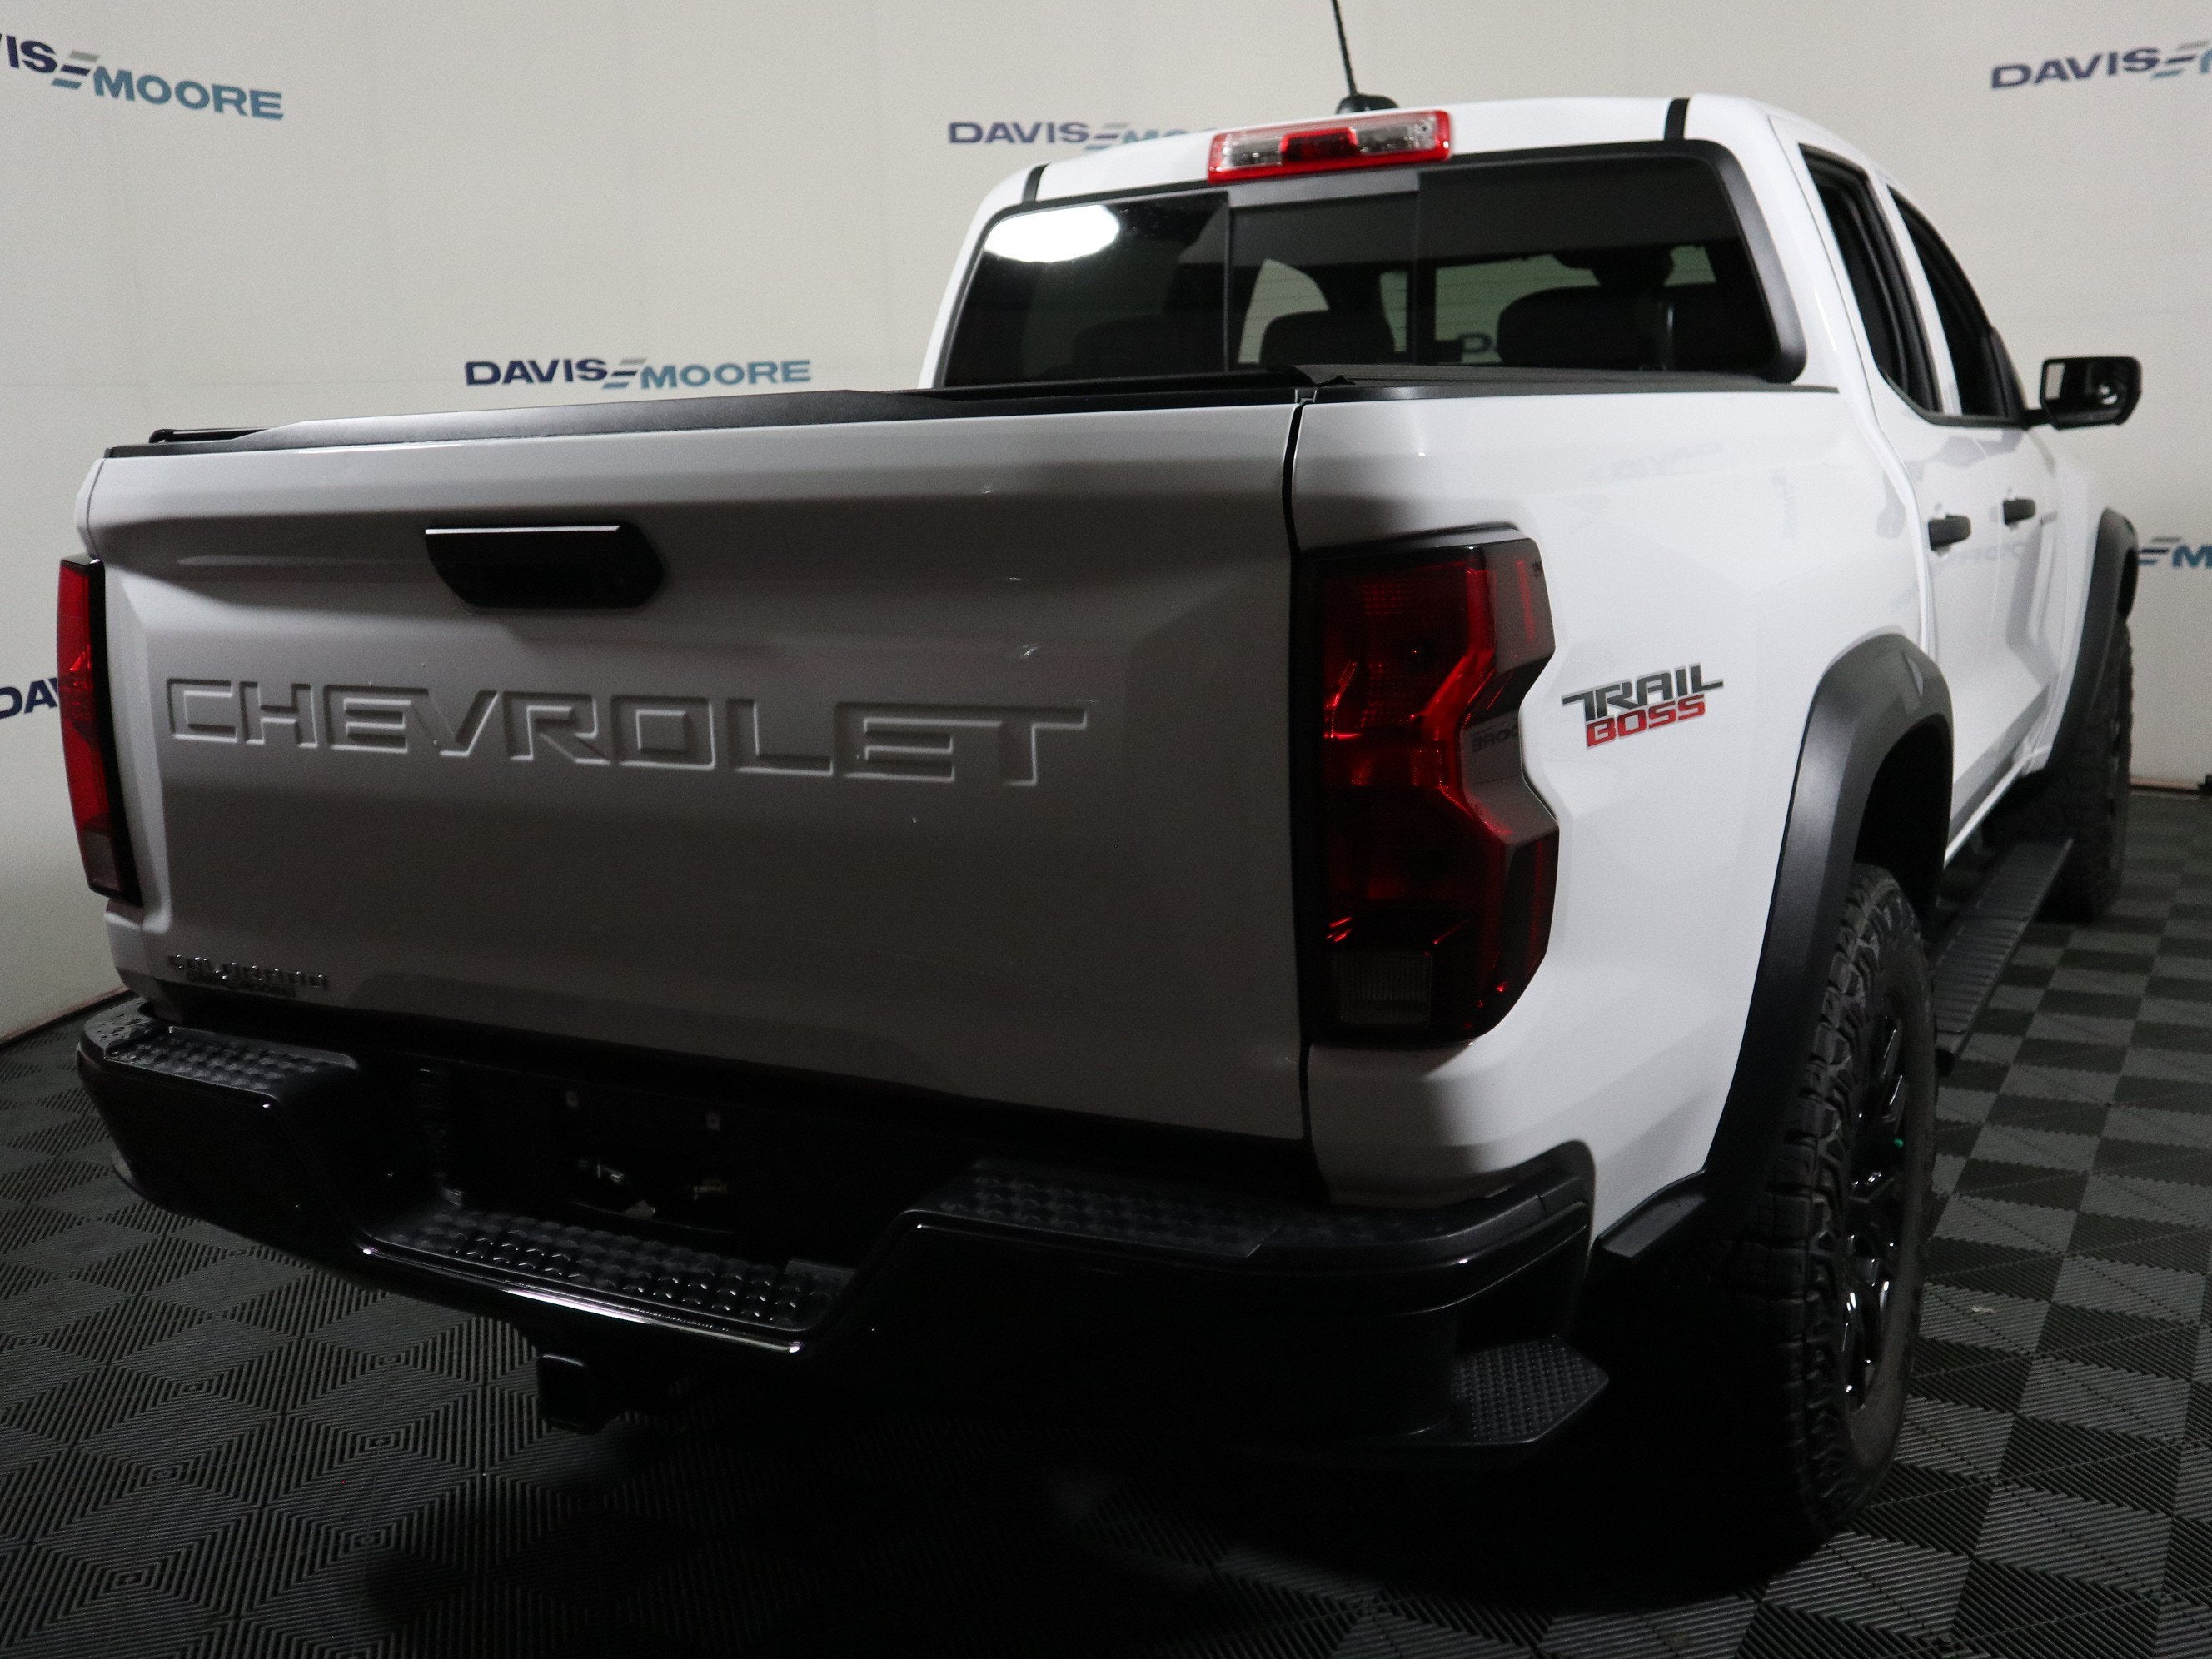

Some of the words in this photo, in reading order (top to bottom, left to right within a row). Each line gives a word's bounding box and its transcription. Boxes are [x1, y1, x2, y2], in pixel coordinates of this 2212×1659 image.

[92, 66, 284, 120] MOORE
[1991, 47, 2160, 88] DAVIS
[948, 121, 1089, 143] DAVIS
[464, 358, 607, 386] DAVIS
[640, 359, 811, 390] MOORE
[1562, 663, 1724, 722] TRAIL
[167, 678, 1089, 787] CHEVROLET
[1586, 693, 1706, 750] BOSS
